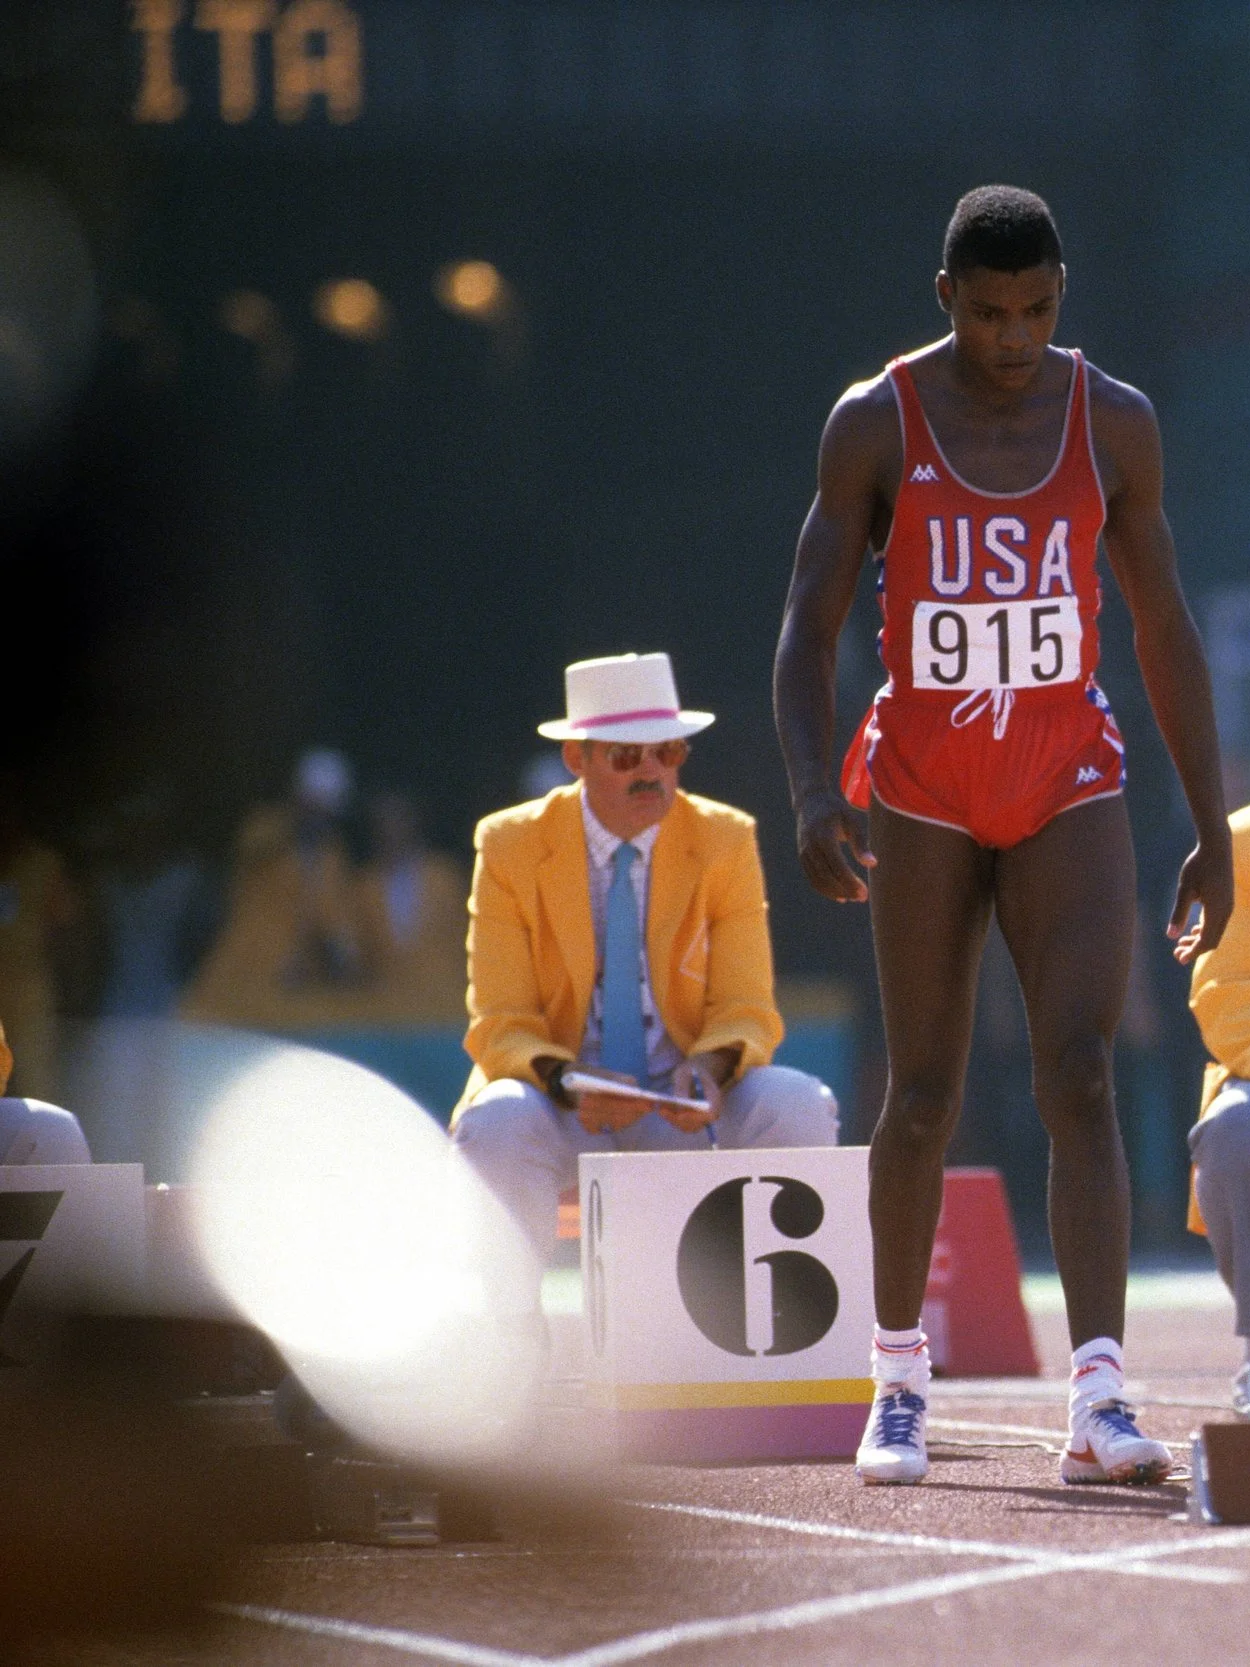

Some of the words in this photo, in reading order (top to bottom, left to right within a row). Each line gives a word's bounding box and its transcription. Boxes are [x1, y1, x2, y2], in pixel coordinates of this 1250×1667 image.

[927, 515, 1074, 596] USA
[928, 604, 1064, 685] 915
[676, 1175, 840, 1357] 6
